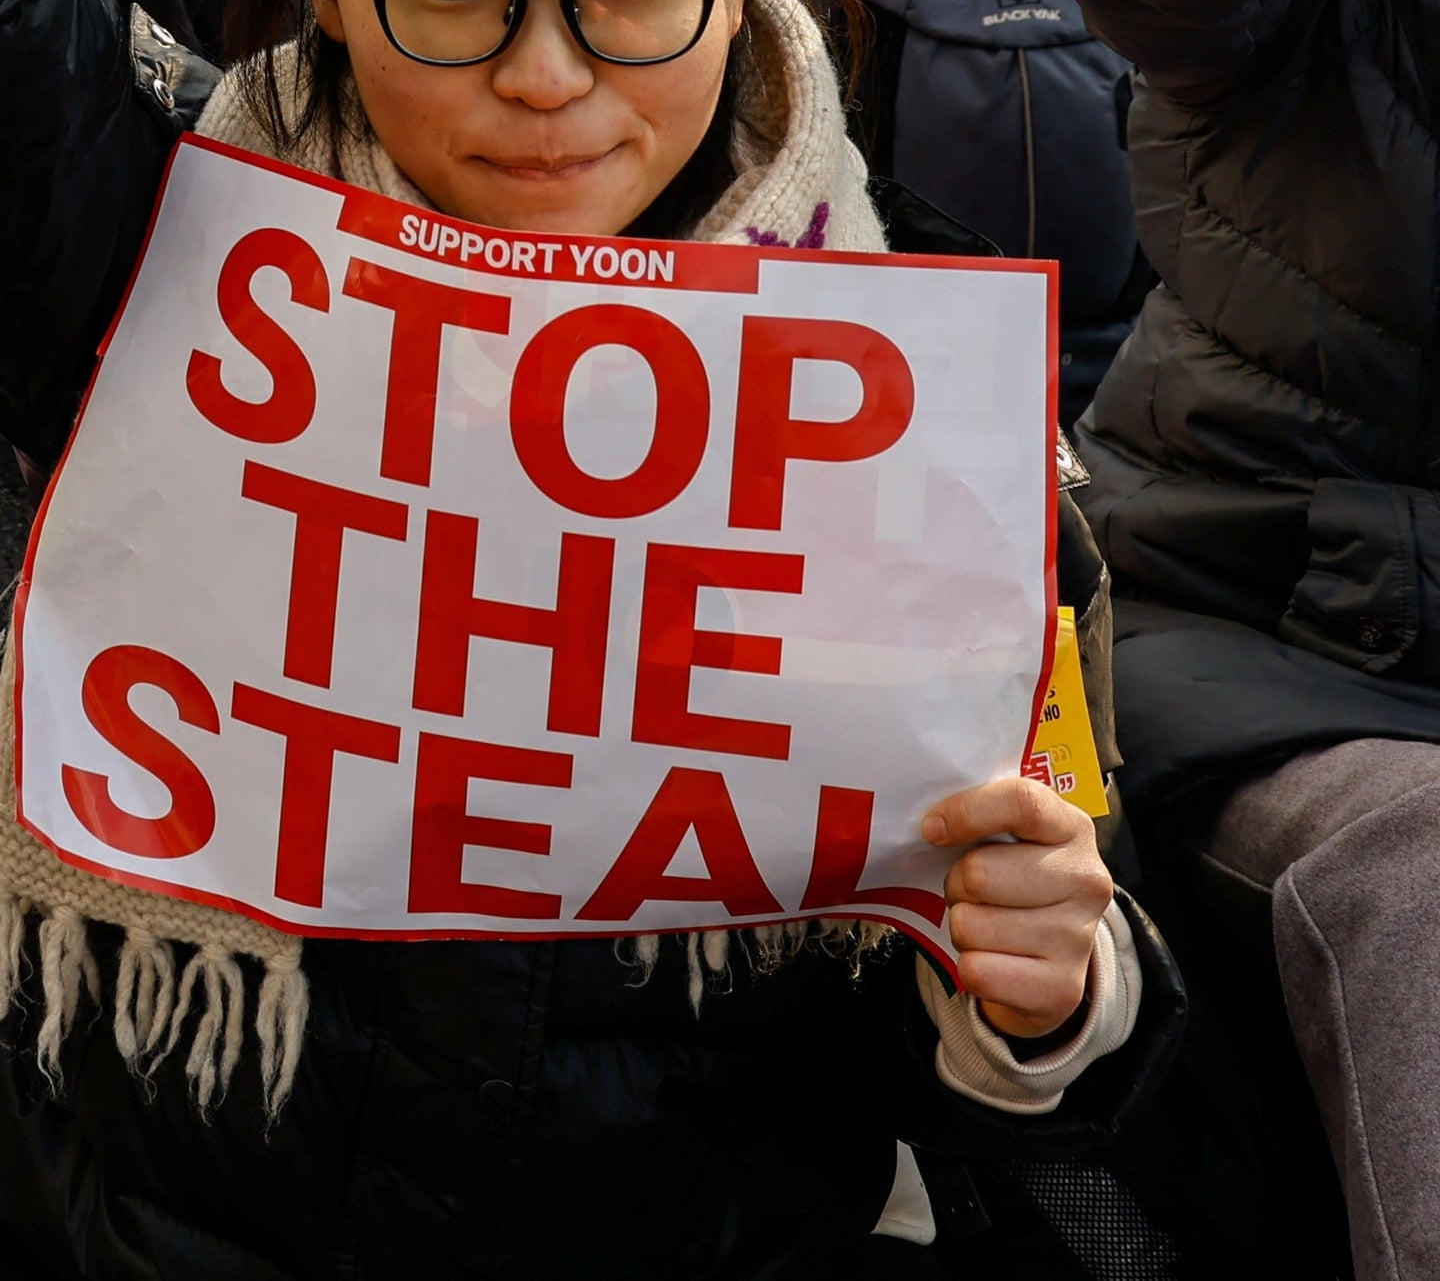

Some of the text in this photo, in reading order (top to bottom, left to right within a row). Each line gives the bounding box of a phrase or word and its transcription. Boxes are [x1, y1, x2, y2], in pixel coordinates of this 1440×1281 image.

[185, 227, 916, 531] STOP
[399, 214, 674, 283] SUPPORT YOON
[241, 460, 806, 761] THE
[61, 645, 948, 929] STEAL
